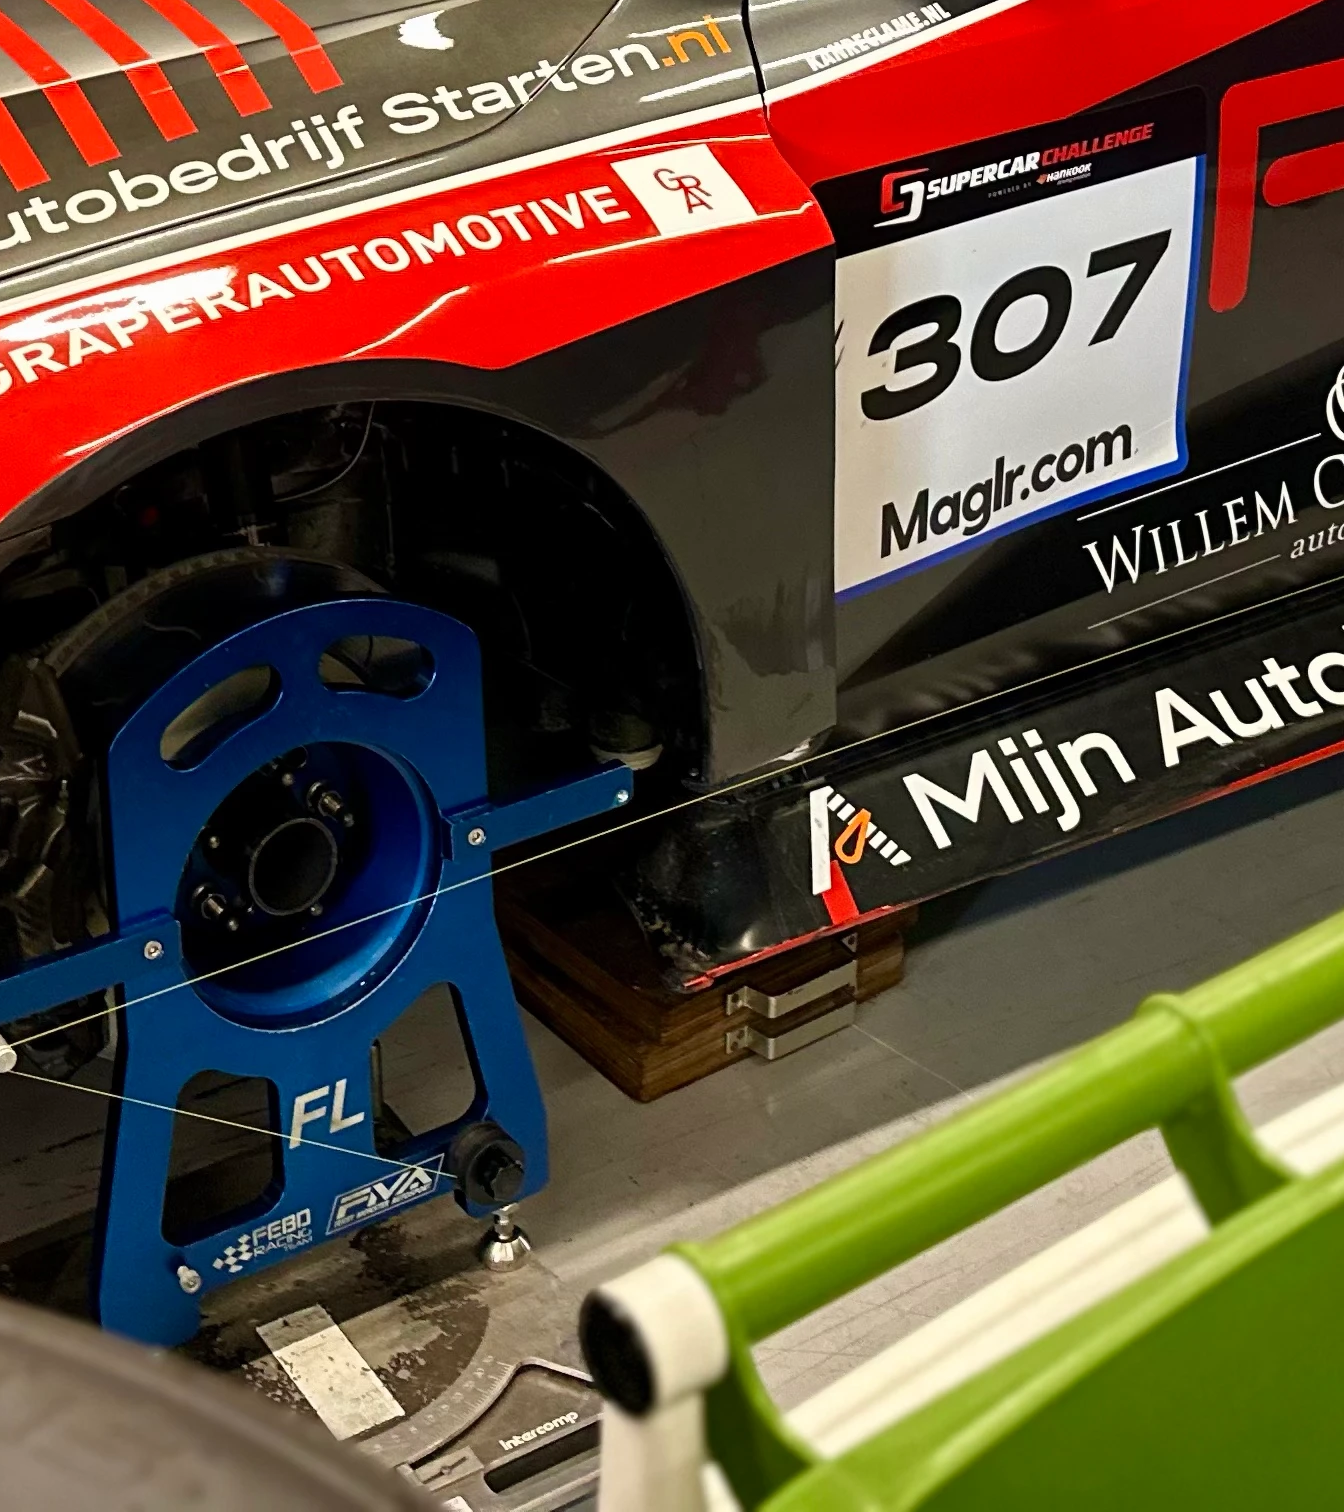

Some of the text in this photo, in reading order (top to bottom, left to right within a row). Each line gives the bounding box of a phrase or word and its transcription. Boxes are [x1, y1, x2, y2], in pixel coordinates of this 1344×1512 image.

[379, 15, 733, 136] Starten.nl
[926, 122, 1155, 200] SUPERCAR CHALLENGE
[861, 227, 1172, 422] 307
[879, 419, 1133, 559] Maglr.com
[1082, 481, 1296, 594] WILLEM
[903, 718, 1133, 851] Mijn
[289, 1078, 365, 1149] FL
[253, 1227, 313, 1257] RACING
[284, 1235, 313, 1252] TEAM
[498, 1410, 579, 1451] Intercomp
